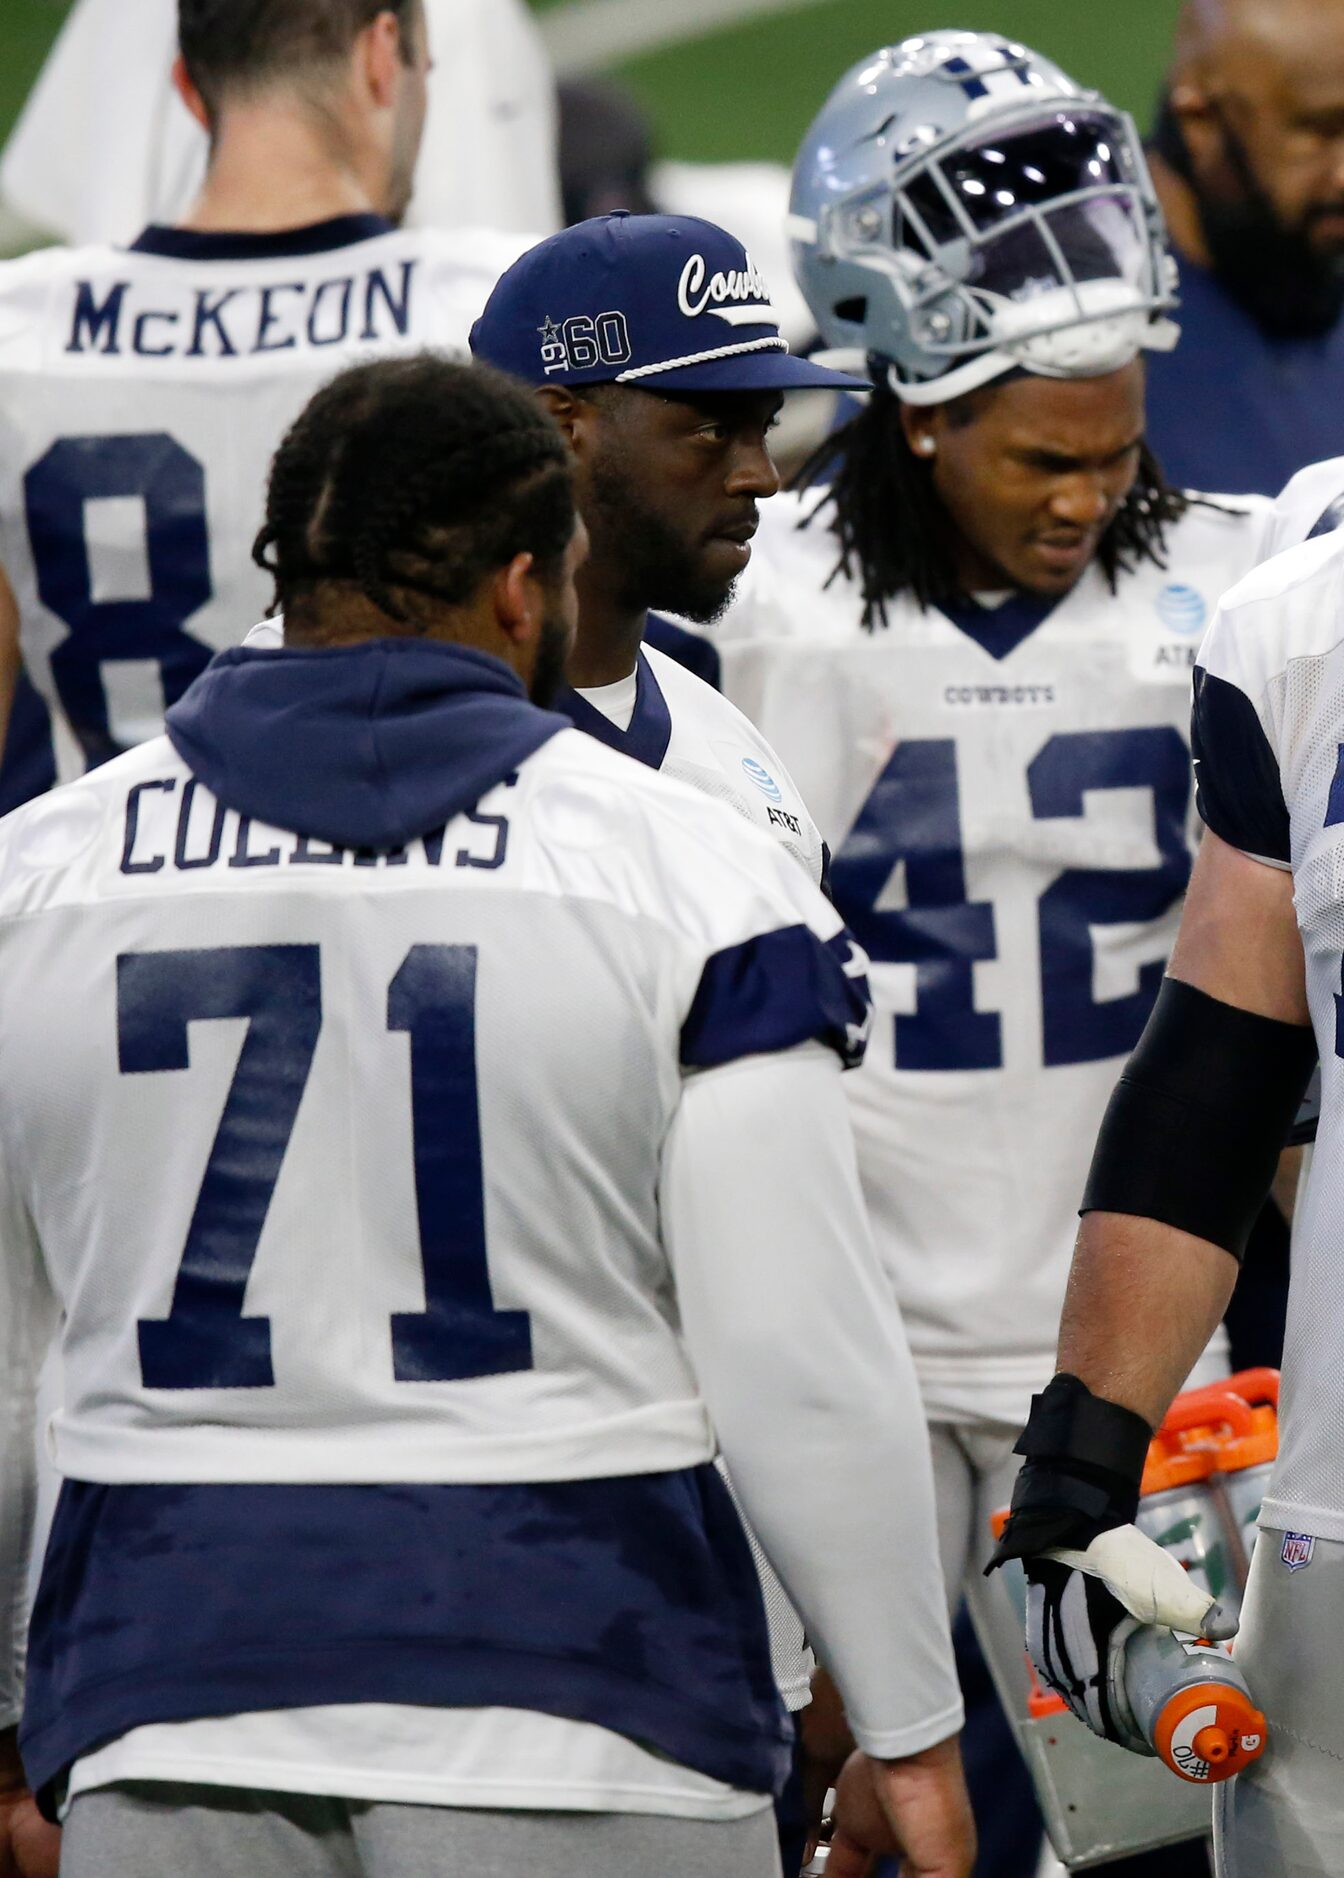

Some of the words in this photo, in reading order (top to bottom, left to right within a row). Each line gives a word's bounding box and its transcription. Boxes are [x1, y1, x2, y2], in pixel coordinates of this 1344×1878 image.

[65, 258, 417, 358] McKEON
[562, 310, 631, 369] 60
[944, 684, 1055, 704] COWBOYS
[766, 806, 802, 837] AT&T
[829, 725, 1194, 1071] 42
[115, 943, 536, 1390] 71
[1283, 1540, 1307, 1562] NFL
[1172, 1745, 1211, 1779] #70
